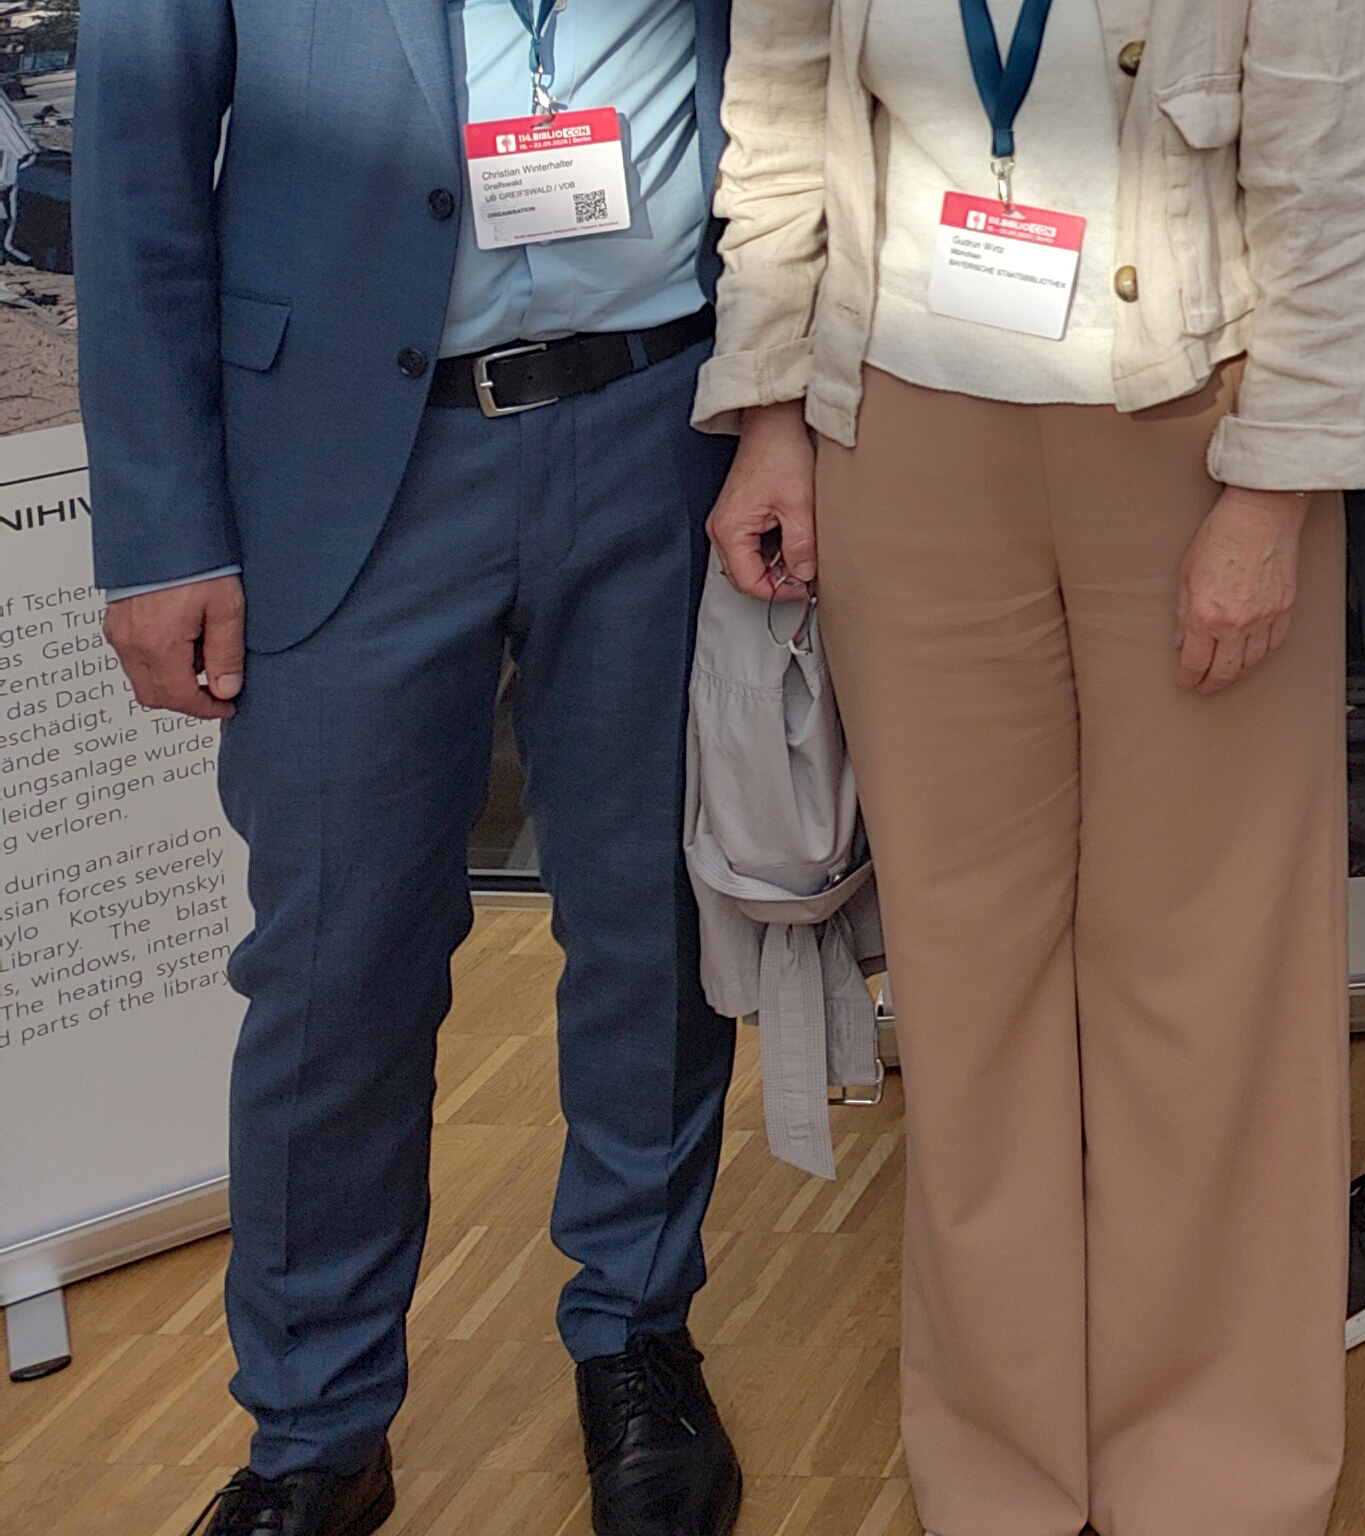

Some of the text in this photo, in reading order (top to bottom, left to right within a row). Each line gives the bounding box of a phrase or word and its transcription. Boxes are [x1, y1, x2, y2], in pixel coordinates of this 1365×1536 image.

[482, 159, 573, 180] Christian Winterhalter
[500, 185, 552, 200] GREIFSWALD
[7, 681, 114, 721] das Dach
[74, 728, 137, 755] sowie
[144, 733, 213, 763] wurde
[163, 757, 215, 783] auch
[2, 773, 154, 825] leider gingen
[27, 807, 128, 844] verloren.
[5, 825, 221, 894] during an air raid on
[58, 848, 223, 906] forces severely
[69, 869, 226, 927] Kotsyubynskyi
[109, 918, 150, 940] The
[177, 895, 228, 921] blast
[31, 916, 229, 988] windows, internal
[1, 943, 230, 1021] The heating system
[22, 970, 230, 1045] parts of the library
